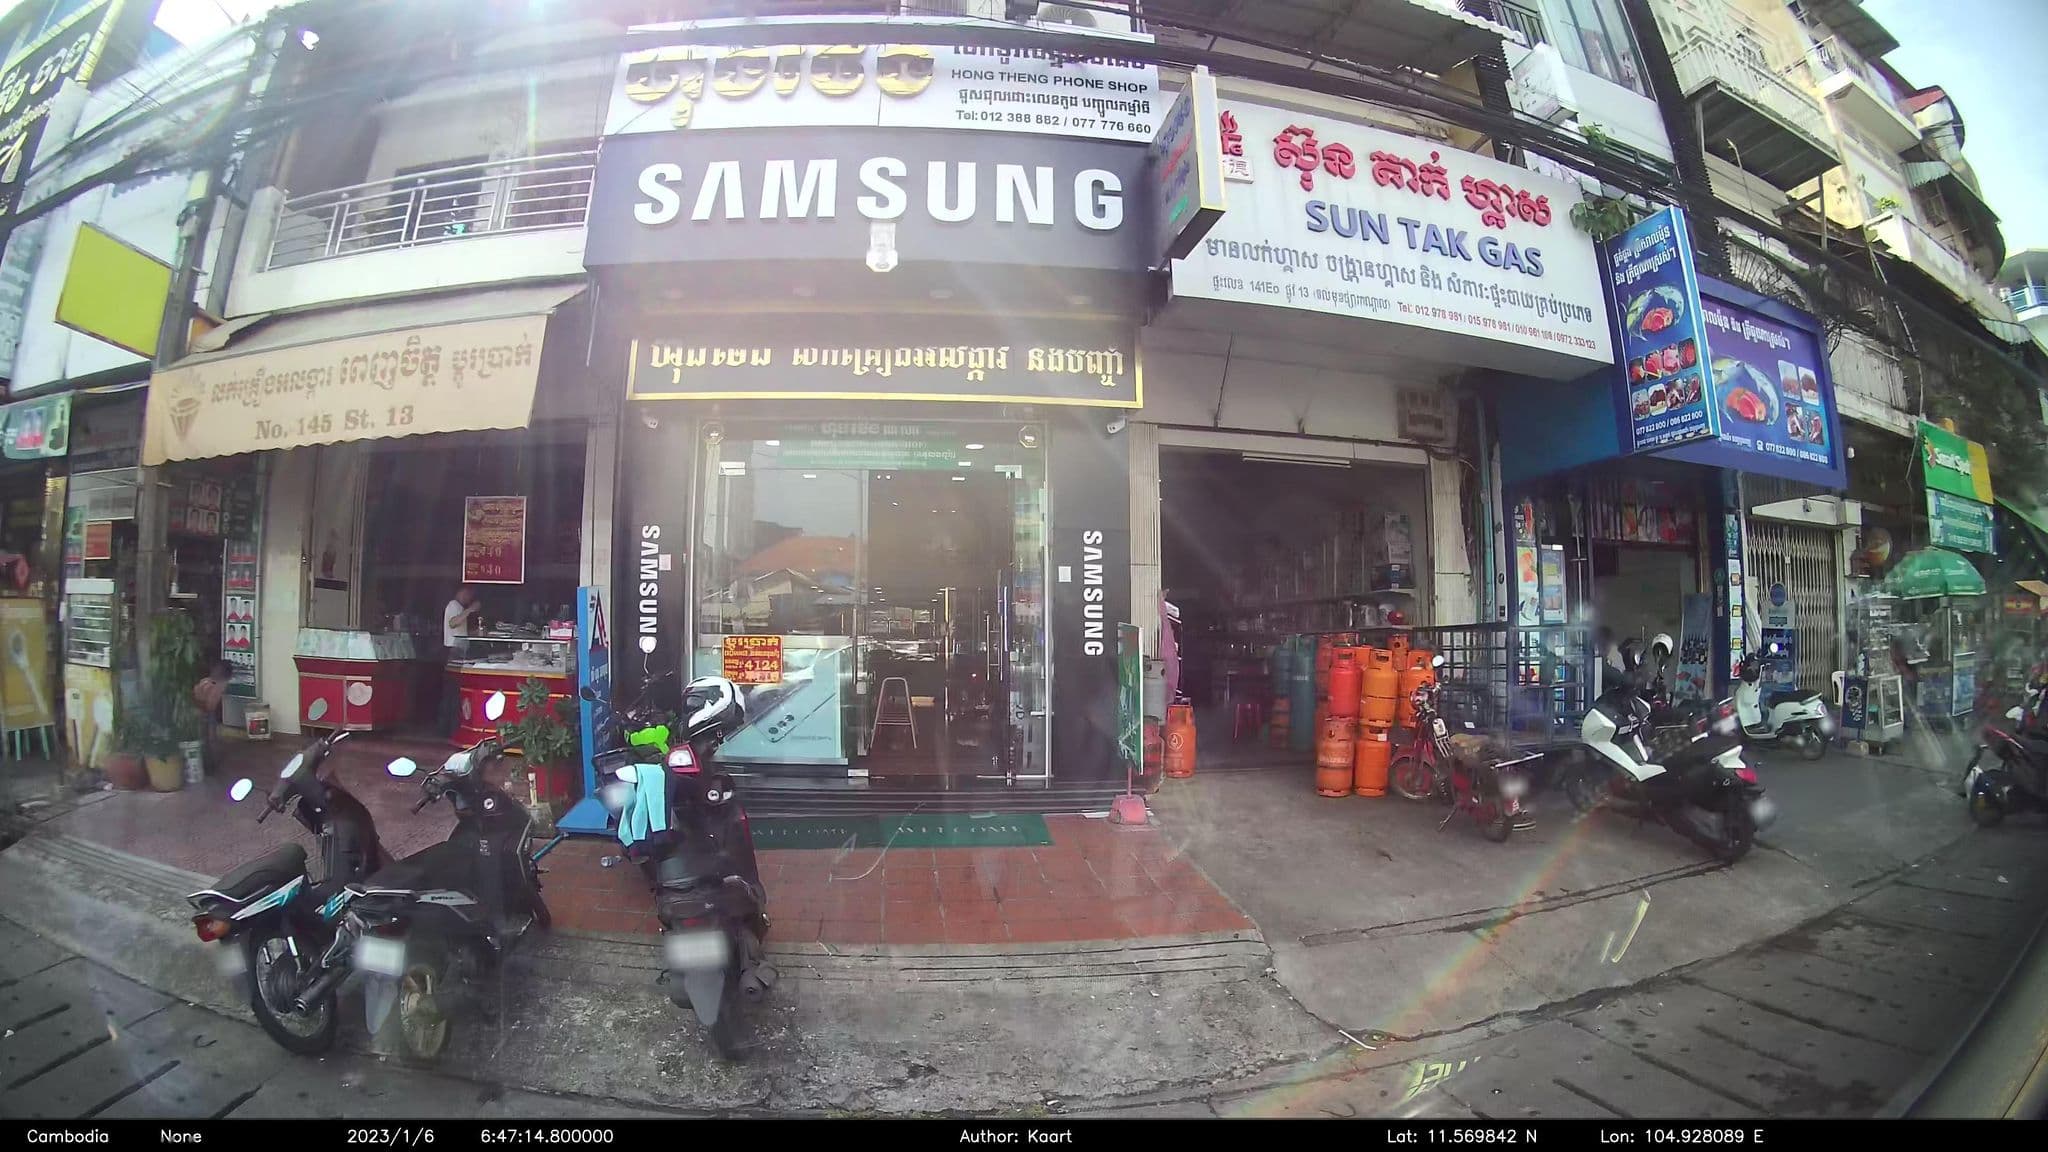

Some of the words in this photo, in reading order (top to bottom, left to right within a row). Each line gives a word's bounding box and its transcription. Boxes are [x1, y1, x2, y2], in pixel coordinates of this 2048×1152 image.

[951, 69, 995, 81] HONG
[999, 71, 1049, 84] THENG
[1053, 76, 1104, 89] PHONE
[1108, 81, 1148, 93] SHOP
[956, 109, 978, 121] Tel:
[981, 111, 1003, 122] 012
[1007, 113, 1031, 124] 388
[1063, 116, 1068, 127] /
[1072, 118, 1096, 129] 077
[1101, 120, 1124, 131] 776
[1127, 123, 1151, 134] 660
[633, 156, 1124, 231] SAMSUNG
[1305, 200, 1390, 244] SUN
[1396, 216, 1472, 261] TAK
[1477, 236, 1544, 278] GAS
[1298, 286, 1309, 298] 13
[1415, 304, 1429, 317] 012
[1467, 313, 1481, 326] 015
[255, 419, 288, 440] No.
[297, 413, 332, 436] 145
[344, 408, 375, 431] St.
[386, 405, 414, 427] 13
[639, 525, 660, 650] SAMSUN
[1083, 530, 1104, 656] SAMSUNG
